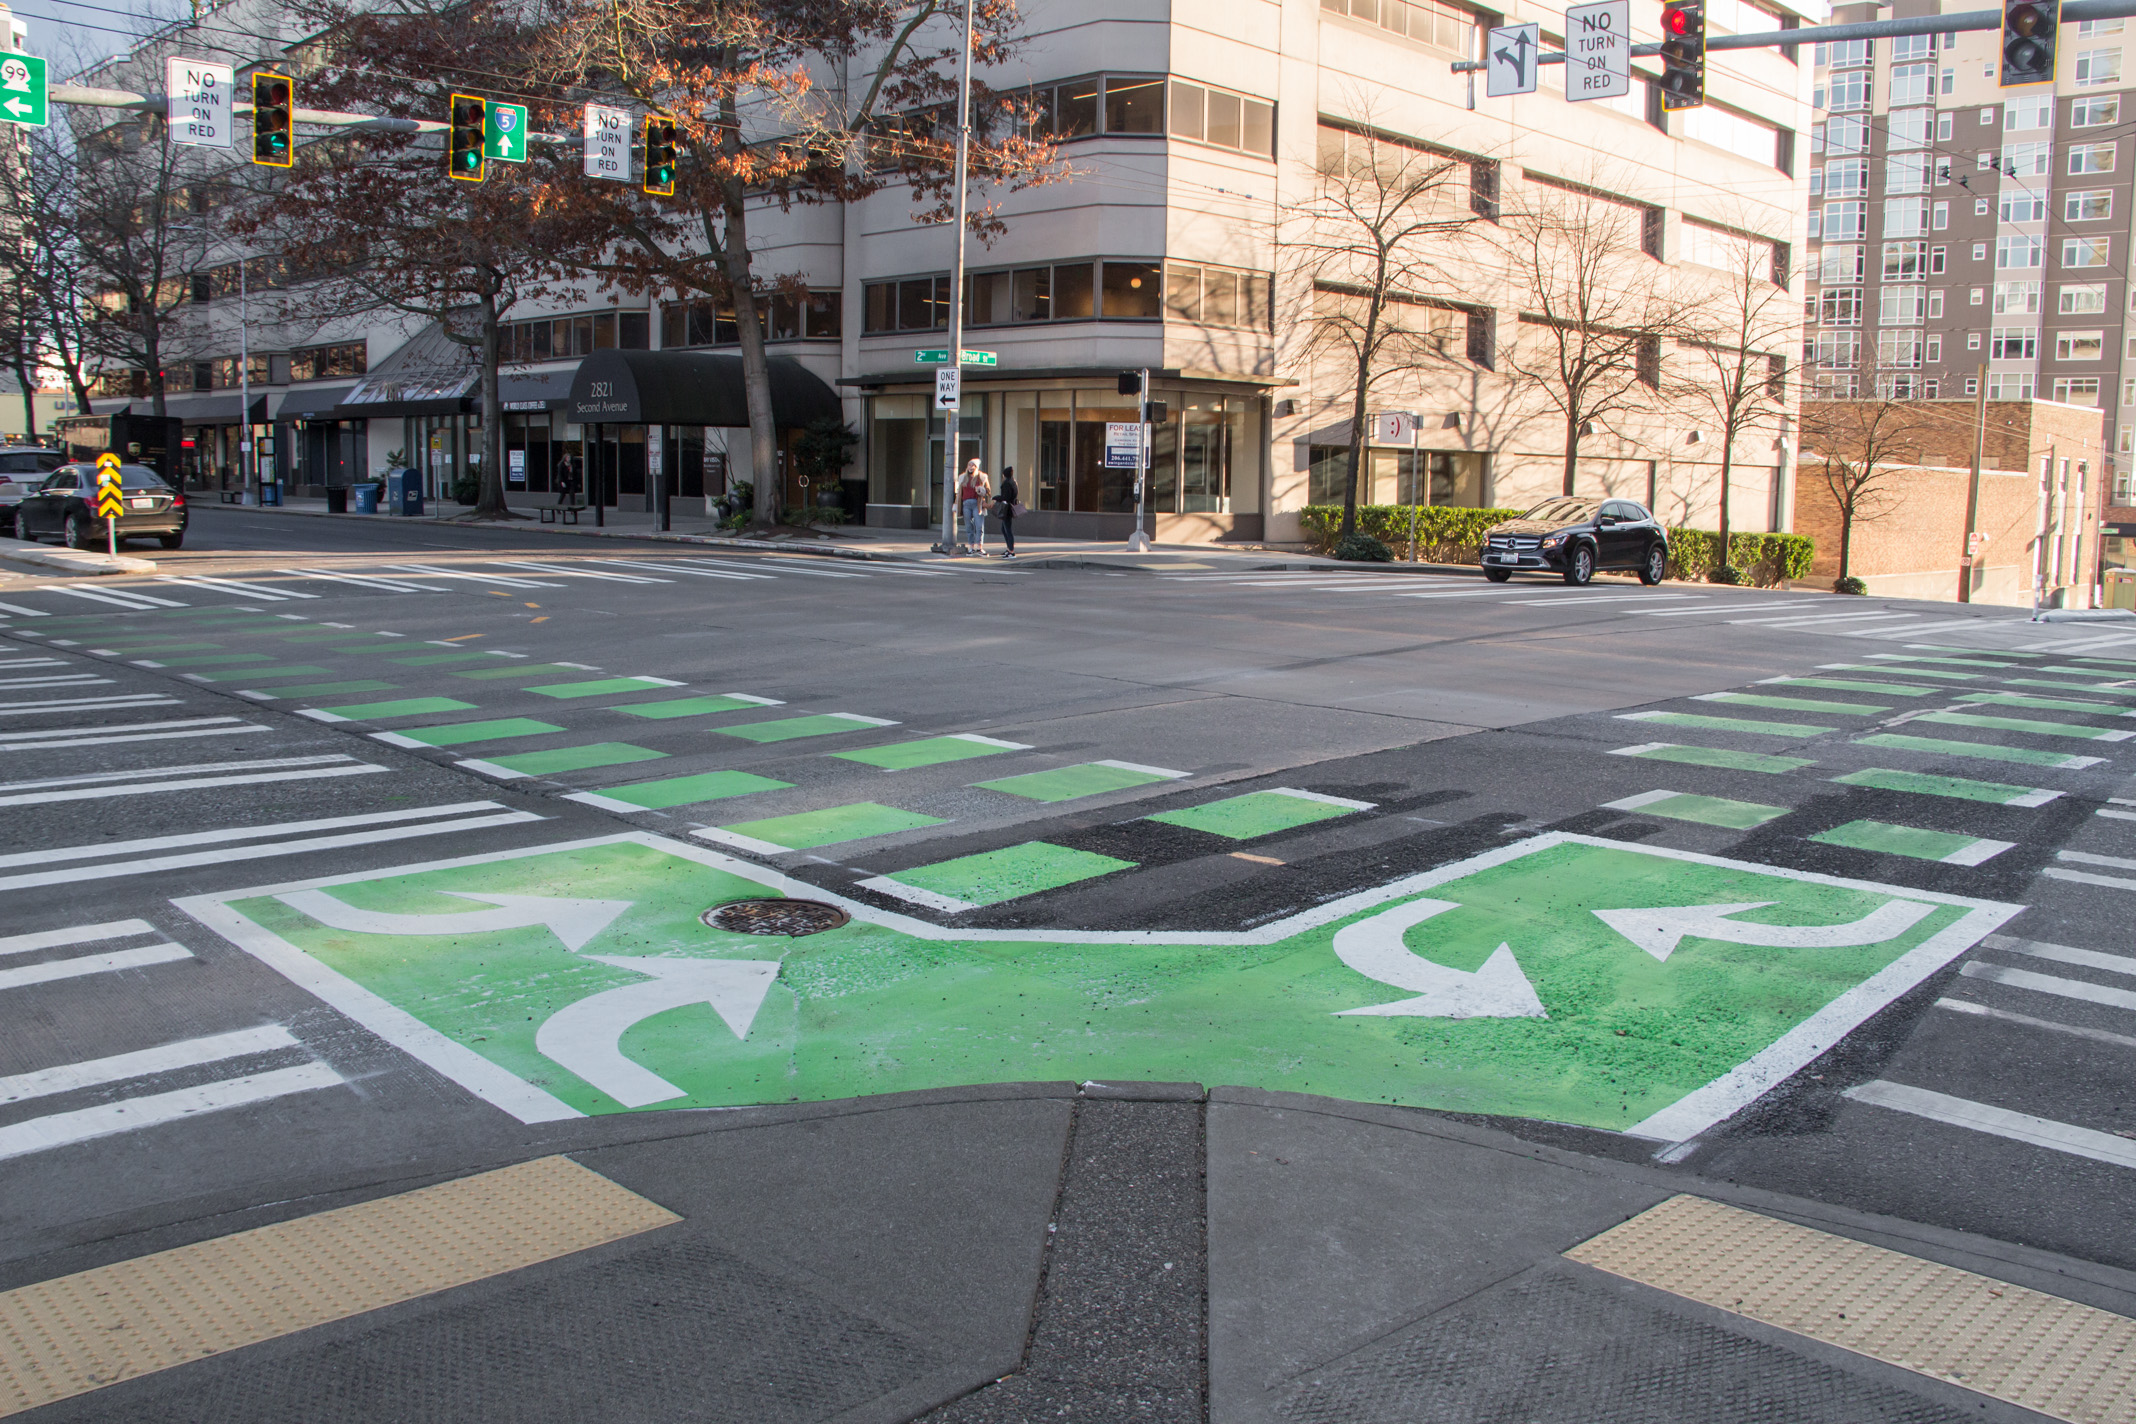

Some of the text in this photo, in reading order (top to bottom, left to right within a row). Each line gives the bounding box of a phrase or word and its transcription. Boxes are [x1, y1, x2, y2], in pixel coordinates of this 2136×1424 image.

[1583, 12, 1611, 32] NO
[1579, 35, 1615, 52] TURN
[1587, 55, 1606, 70] ON
[5, 66, 26, 81] 99
[187, 70, 215, 88] NO
[1583, 74, 1610, 90] RED
[184, 90, 219, 105] TURN
[192, 107, 211, 121] ON
[501, 115, 510, 128] 5
[599, 114, 618, 129] NO
[188, 123, 216, 138] RED
[596, 131, 621, 144] TURN
[601, 146, 615, 157] ON
[598, 160, 617, 171] RED
[961, 351, 979, 362] Broad
[941, 372, 955, 381] ONE
[591, 382, 613, 398] 2821
[940, 383, 955, 392] WAY
[577, 401, 627, 413] Second Avenue
